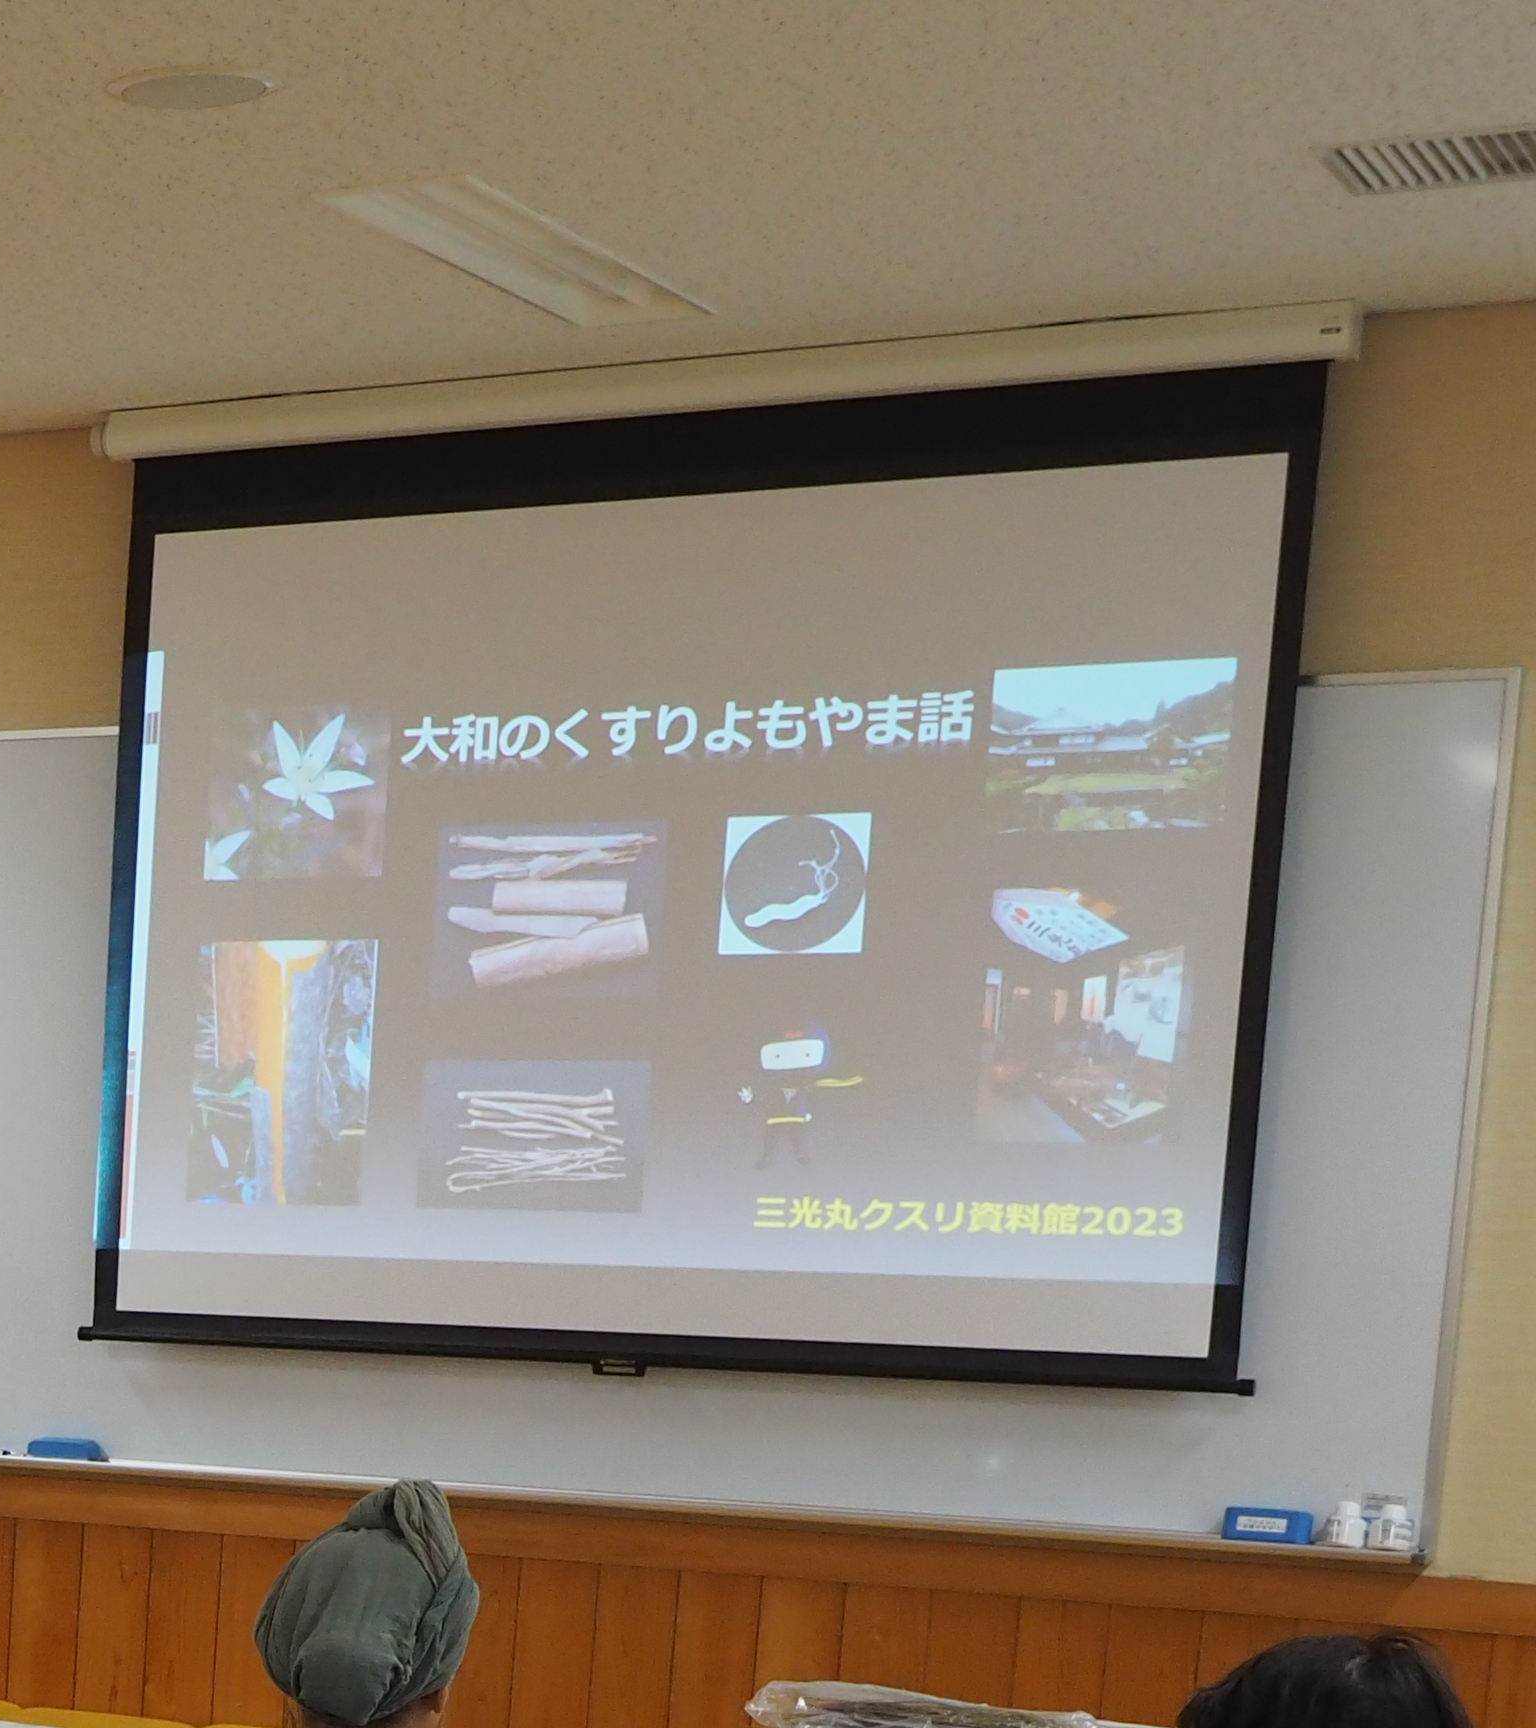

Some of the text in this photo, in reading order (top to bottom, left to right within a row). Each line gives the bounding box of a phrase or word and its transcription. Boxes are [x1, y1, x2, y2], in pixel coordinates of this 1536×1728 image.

[400, 689, 975, 766] 大和のくすりよもやま話
[753, 1196, 1185, 1237] 三光丸クスリ資料館2023
